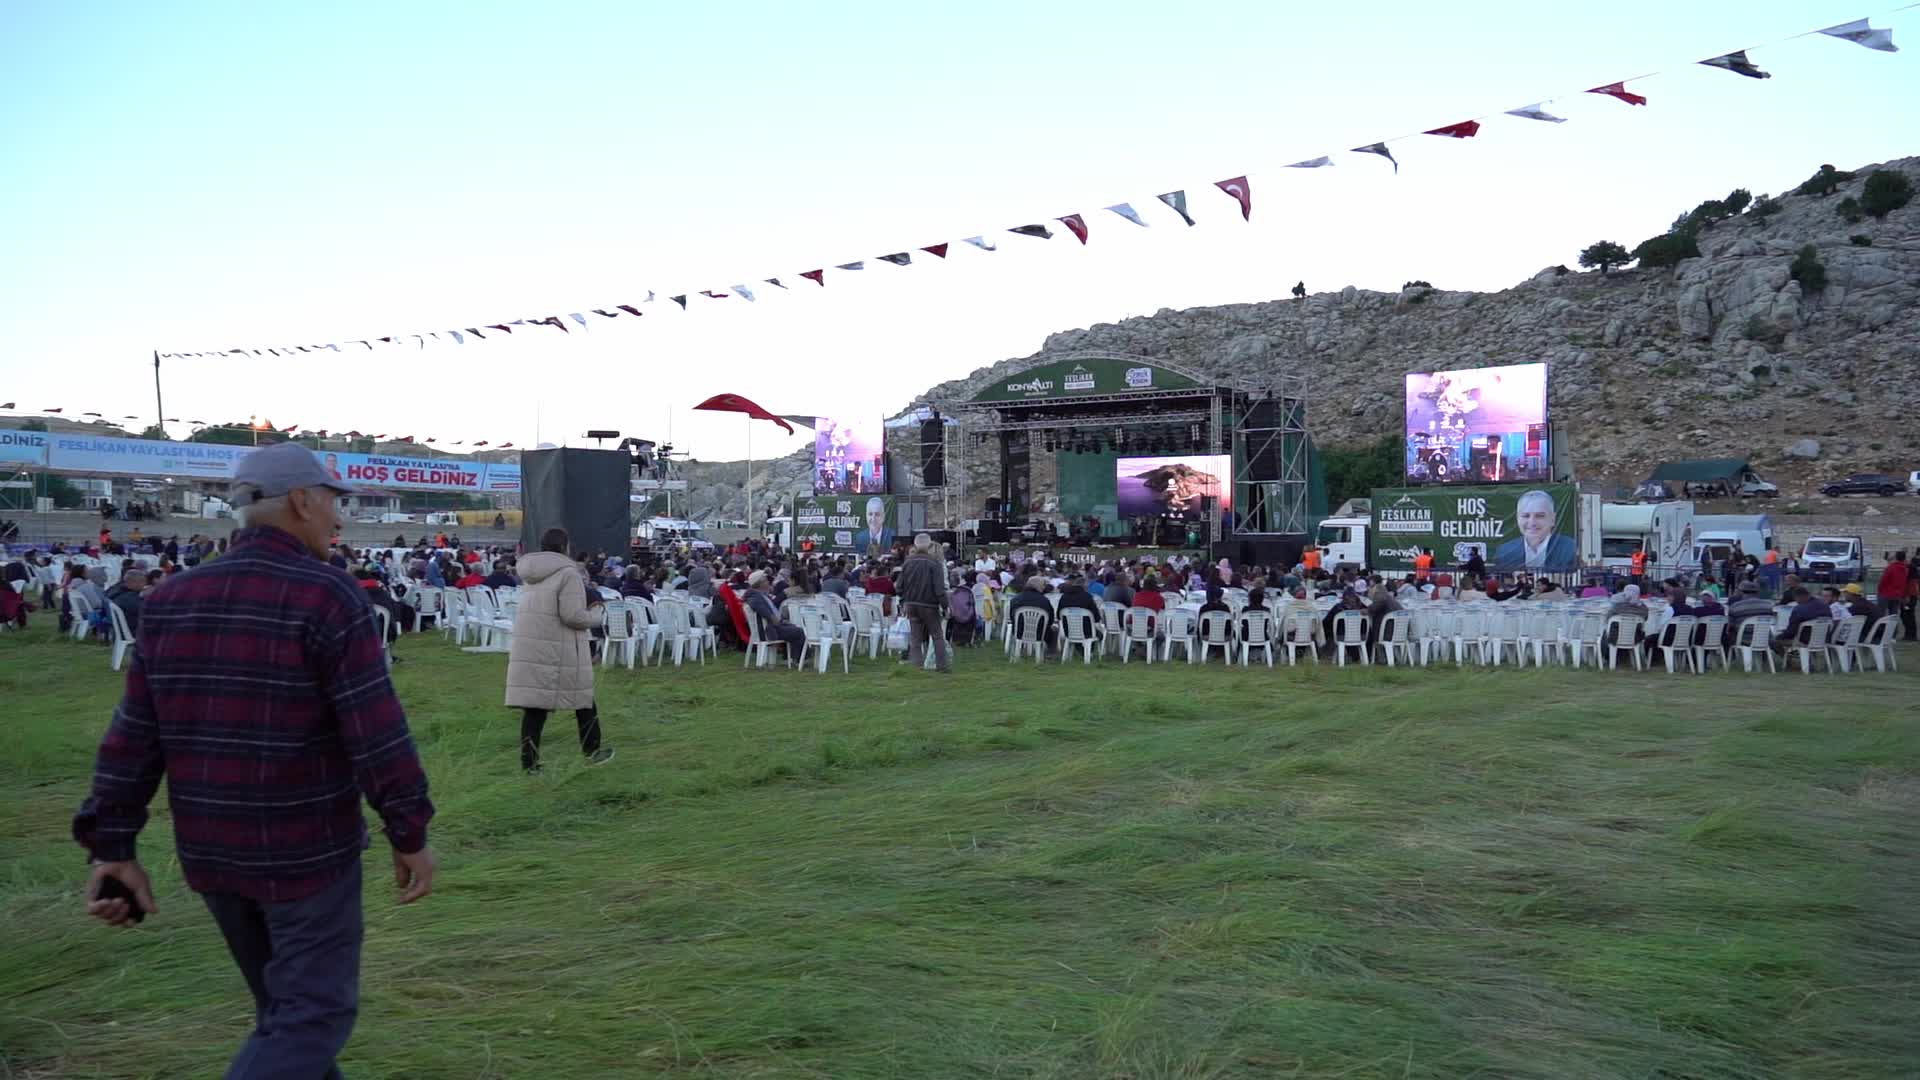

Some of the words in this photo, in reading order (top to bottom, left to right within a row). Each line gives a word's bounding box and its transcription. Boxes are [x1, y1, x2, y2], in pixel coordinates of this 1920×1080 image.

[347, 464, 389, 483] HOŞ
[394, 468, 478, 486] GELDİNİZ
[836, 501, 851, 516] HOŞ
[1381, 509, 1431, 520] FESLIKAN
[1457, 498, 1486, 518] HOŞ
[1440, 517, 1504, 537] GELDİNİZ
